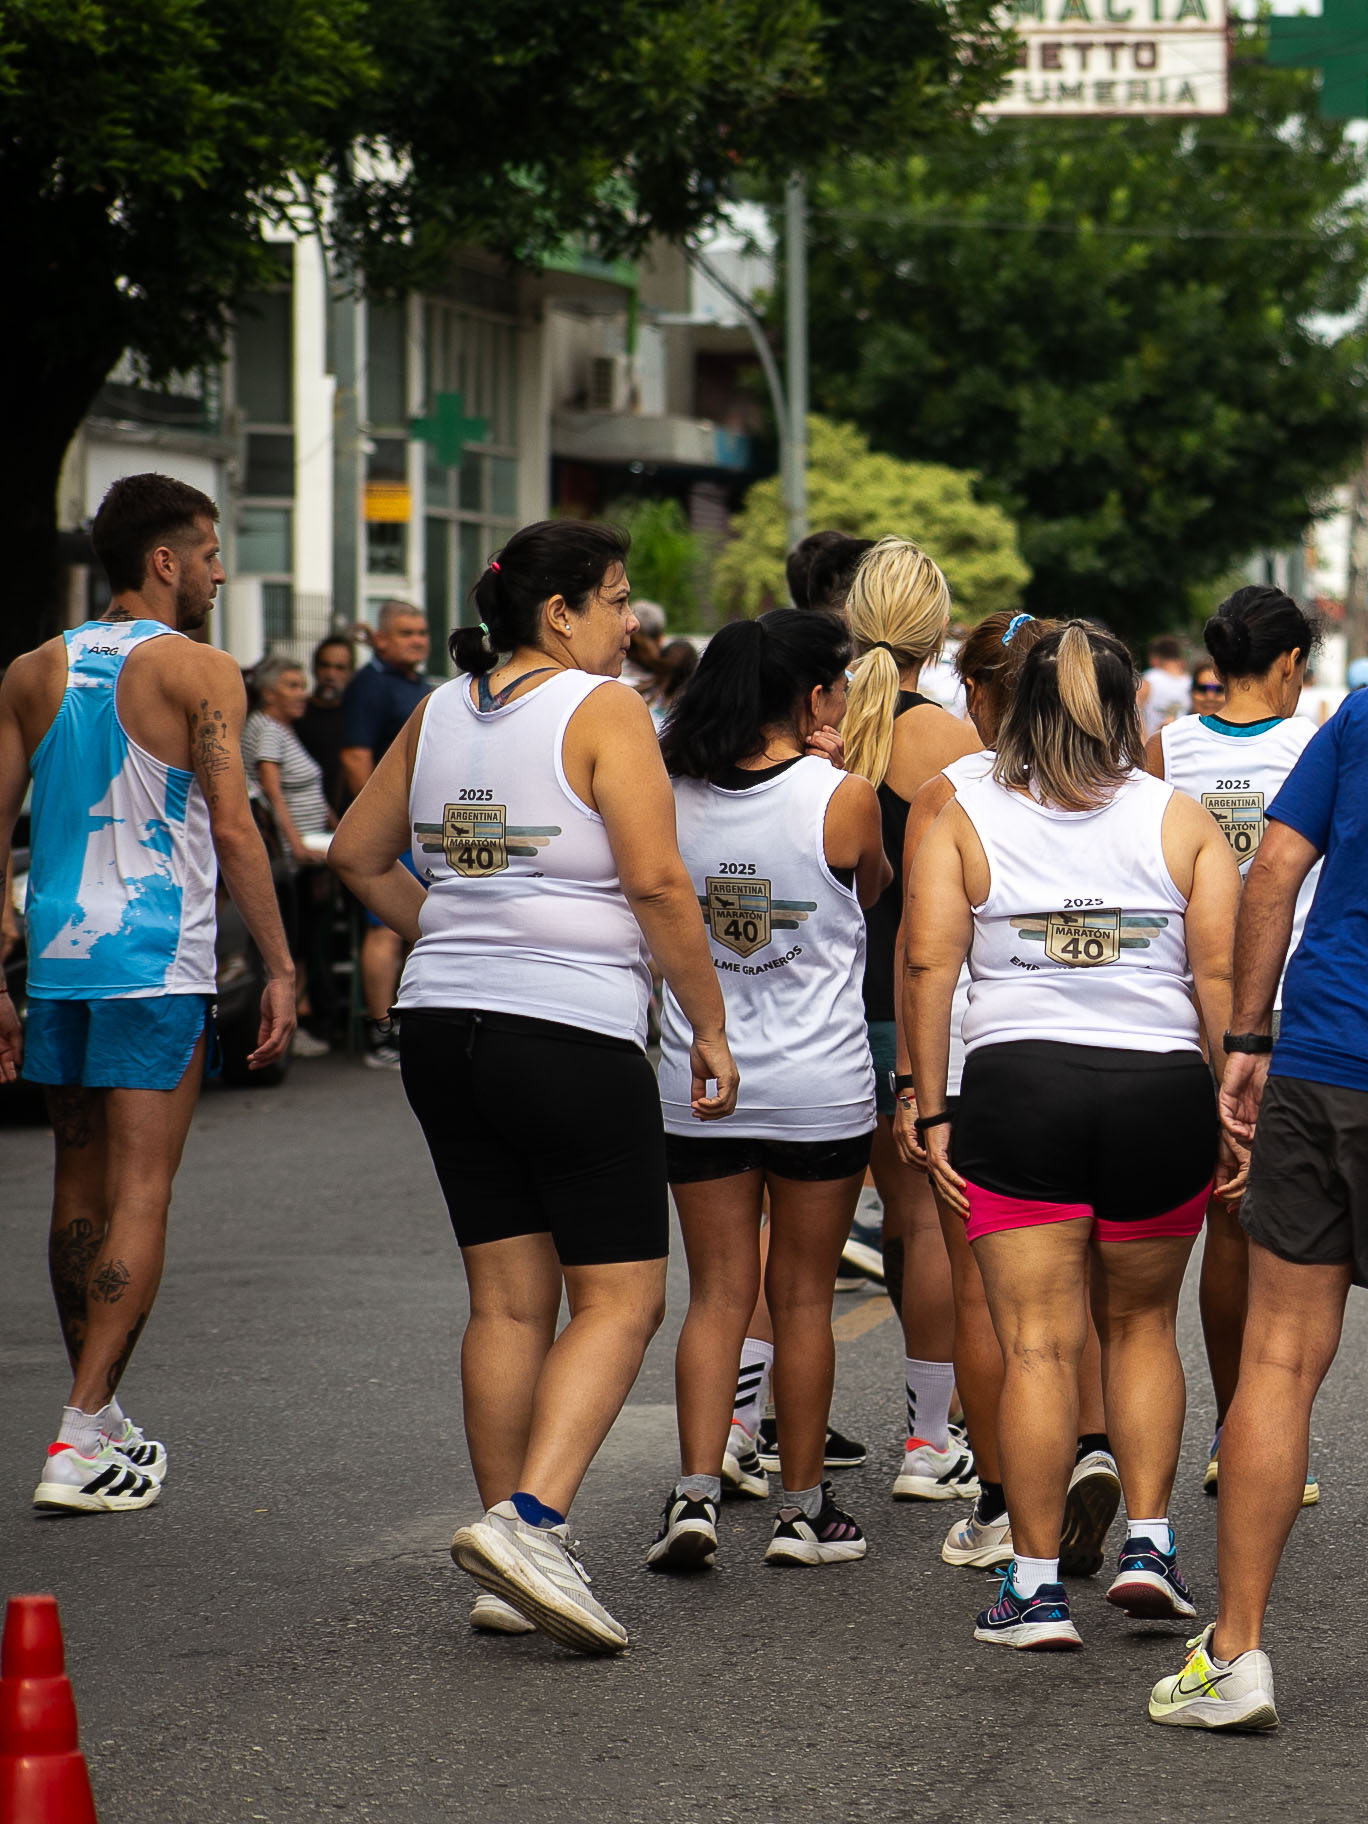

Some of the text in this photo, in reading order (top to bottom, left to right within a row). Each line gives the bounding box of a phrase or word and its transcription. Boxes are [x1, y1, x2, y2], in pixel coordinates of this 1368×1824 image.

[88, 646, 119, 656] ARG
[1216, 779, 1250, 790] 2025
[459, 788, 493, 801] 2025
[1208, 799, 1257, 808] ARGENTINA
[450, 811, 499, 821] ARGENTINA
[450, 837, 497, 848] MARATÓN
[458, 847, 494, 870] 40
[719, 863, 757, 875] 2025
[713, 885, 763, 895] ARGENTINA
[1063, 898, 1104, 908] 2025
[716, 910, 763, 921] MARATÓN
[724, 920, 758, 943] 40
[1055, 926, 1111, 939] MARATÓN
[1061, 938, 1104, 960] 40
[713, 945, 803, 975] LME GRANEROS
